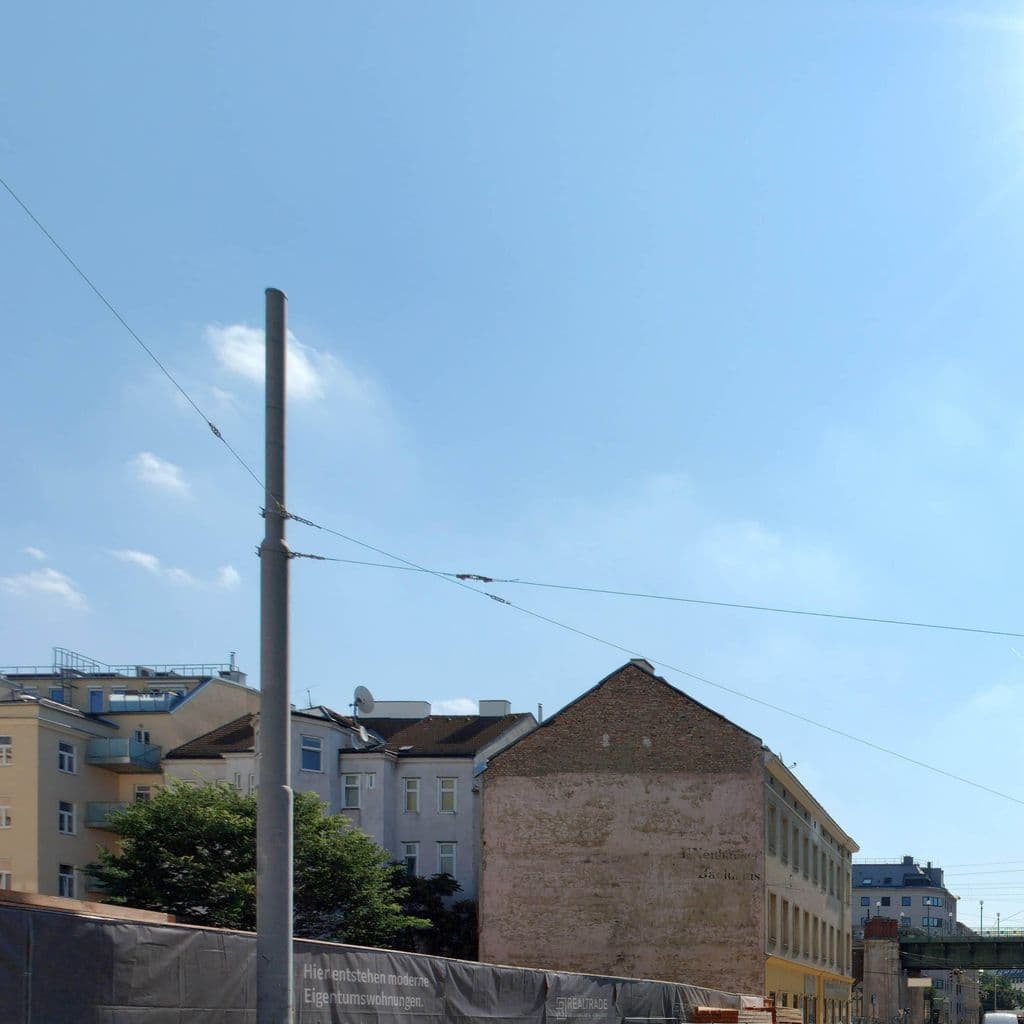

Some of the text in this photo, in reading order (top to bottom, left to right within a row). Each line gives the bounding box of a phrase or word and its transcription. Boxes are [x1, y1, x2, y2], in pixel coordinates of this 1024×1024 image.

[303, 963, 430, 988] Hier entstehen moderne
[304, 988, 424, 1010] Eigentumswohnungen.
[567, 997, 609, 1009] REALTRADE
